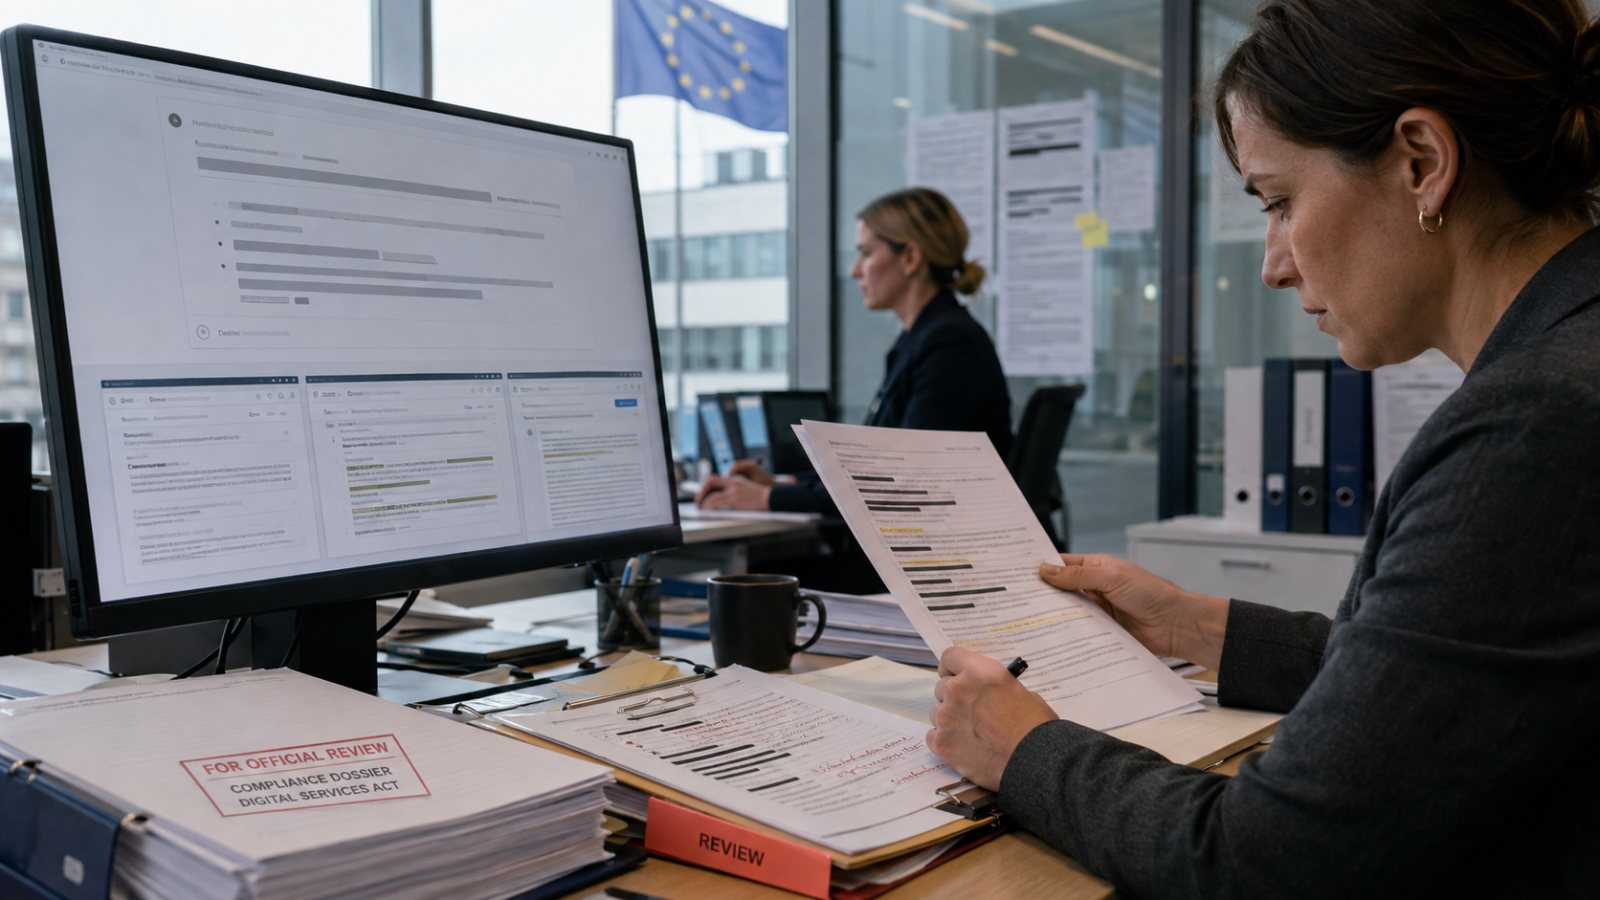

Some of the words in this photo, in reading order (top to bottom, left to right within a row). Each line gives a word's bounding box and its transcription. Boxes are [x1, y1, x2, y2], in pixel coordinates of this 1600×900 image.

[202, 761, 243, 775] FOR
[245, 751, 325, 770] OFFICIAL
[325, 741, 389, 760] REVIEW
[230, 774, 329, 794] COMPLIANCE
[329, 766, 393, 783] DOSSIER
[238, 793, 298, 807] DIGITAL
[298, 784, 370, 801] SERVICES
[372, 780, 399, 792] ACT
[698, 832, 765, 867] REVIEW
